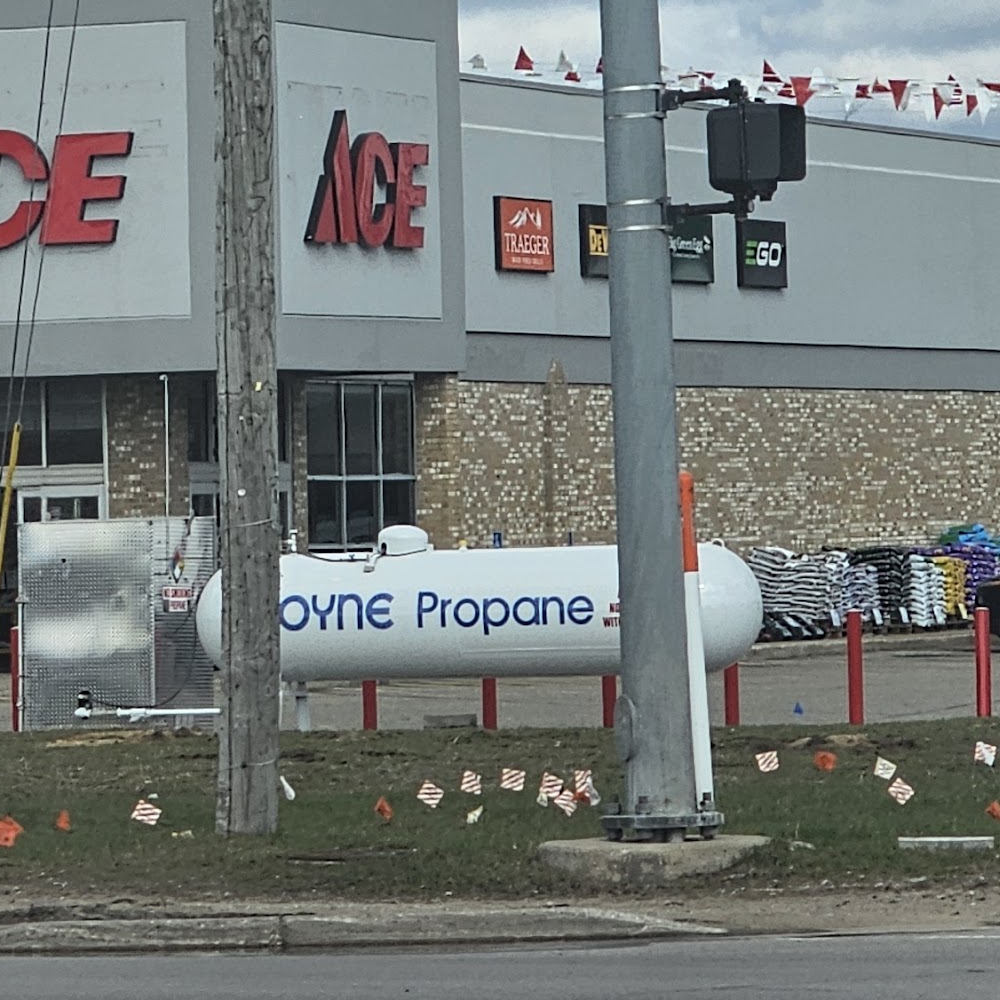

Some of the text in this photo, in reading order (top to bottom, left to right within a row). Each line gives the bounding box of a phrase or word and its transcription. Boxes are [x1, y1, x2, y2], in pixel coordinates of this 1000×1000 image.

[304, 110, 429, 248] ACE
[504, 232, 550, 255] TRAEGER
[745, 240, 782, 267] EGO
[280, 591, 594, 635] OYNE Propane
